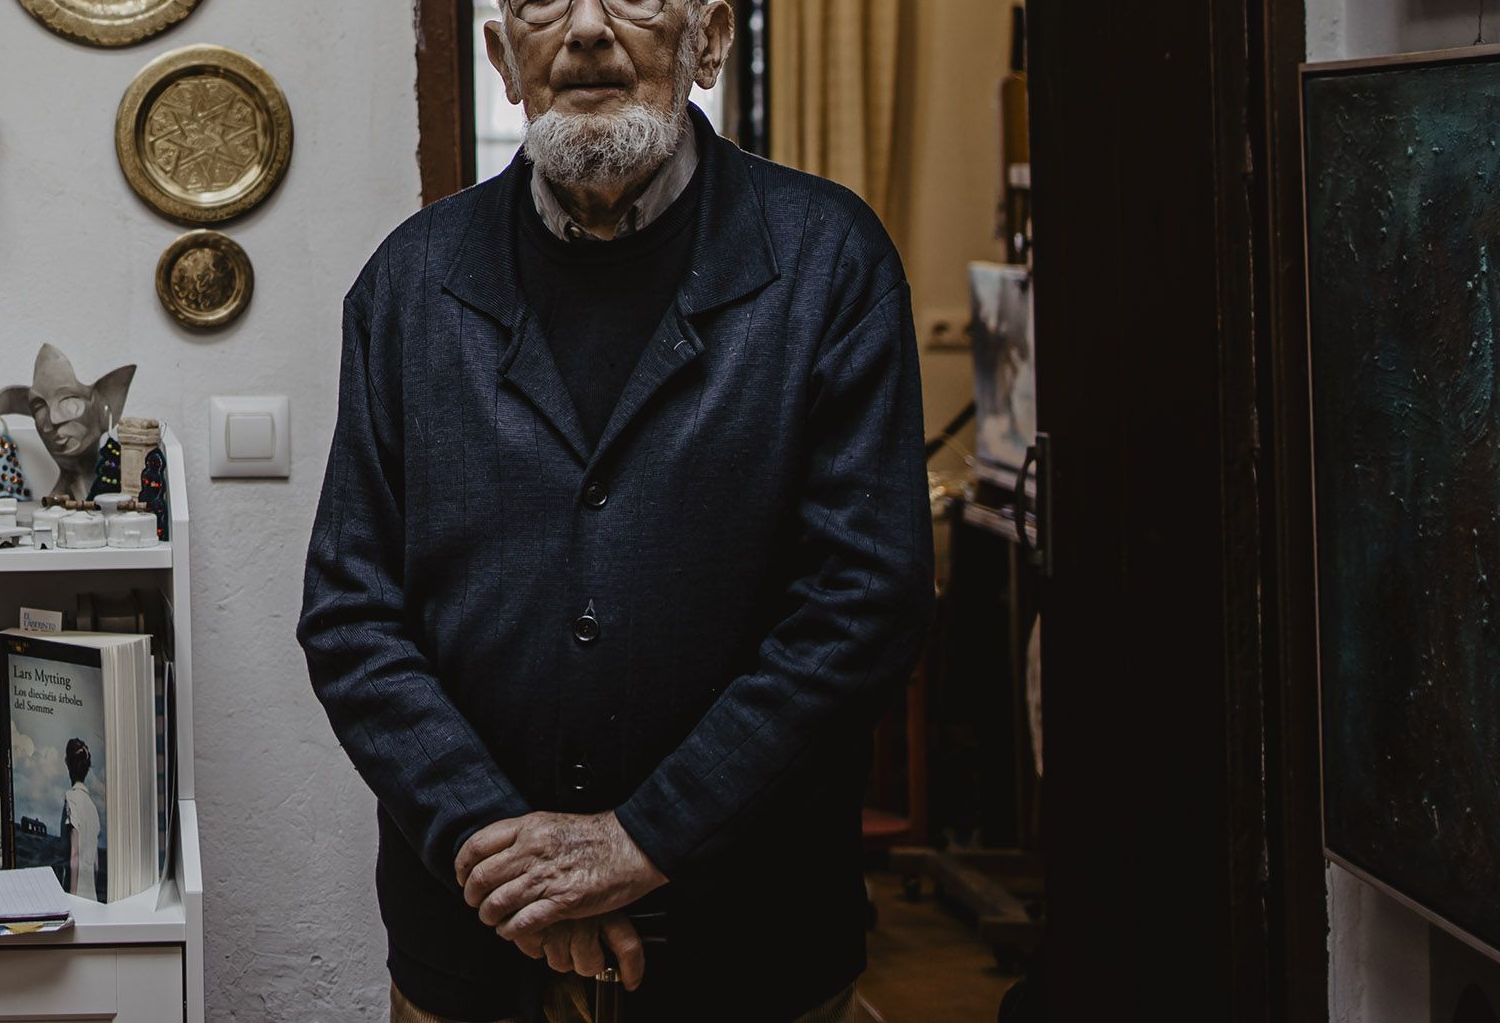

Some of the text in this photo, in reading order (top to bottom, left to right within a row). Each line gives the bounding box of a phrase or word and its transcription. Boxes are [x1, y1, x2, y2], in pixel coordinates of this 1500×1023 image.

[13, 665, 72, 690] Lars Mytting
[14, 685, 83, 707] Los dieciséis árboles
[14, 698, 54, 715] del Somme
